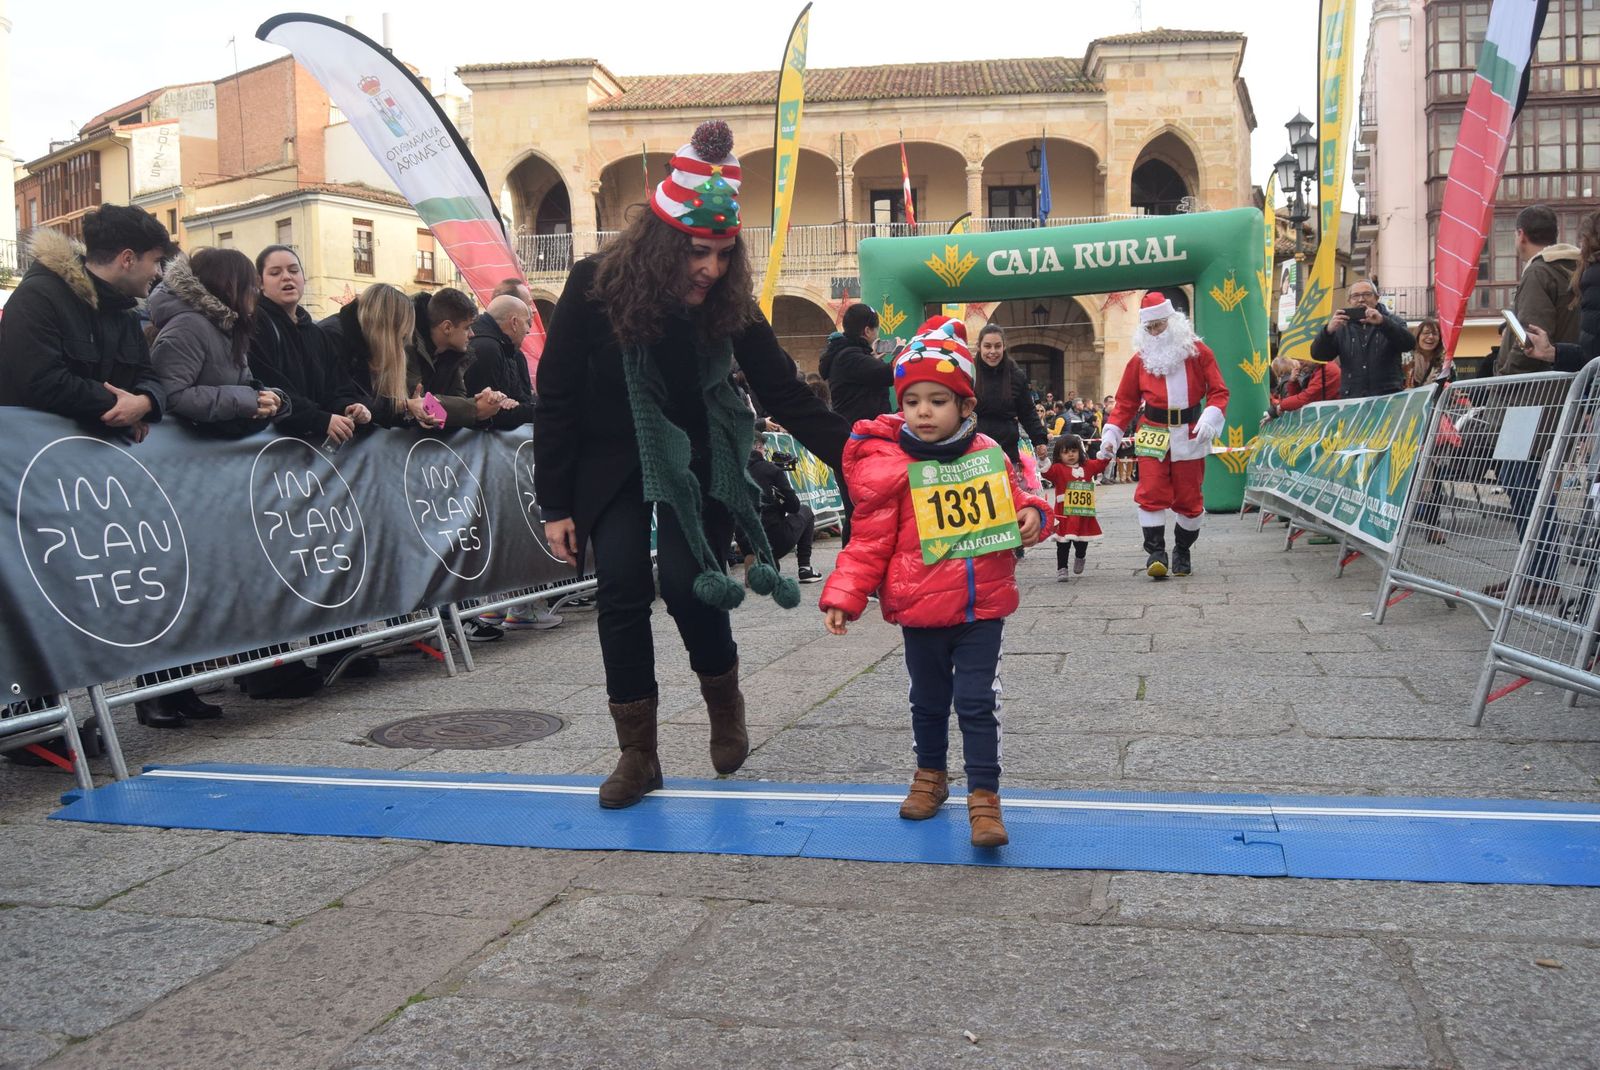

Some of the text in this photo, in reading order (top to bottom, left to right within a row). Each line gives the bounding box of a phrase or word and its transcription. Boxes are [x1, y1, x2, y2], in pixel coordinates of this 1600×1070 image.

[986, 235, 1188, 276] CAJA RURAL
[1138, 431, 1166, 447] 339
[421, 465, 459, 489] IM
[939, 454, 991, 474] FUNDACION
[940, 473, 962, 483] CAJA
[963, 464, 992, 481] RURAL
[57, 476, 132, 511] IM
[273, 470, 325, 498] IM
[1067, 490, 1092, 506] 1358
[415, 495, 482, 523] PLAN
[927, 480, 997, 530] 1331
[263, 506, 353, 540] PLAN
[37, 520, 172, 564] PLAN
[438, 526, 481, 552] TES
[951, 531, 1015, 552] CAJA RURAL
[290, 544, 351, 577] TES
[75, 567, 166, 608] TES
